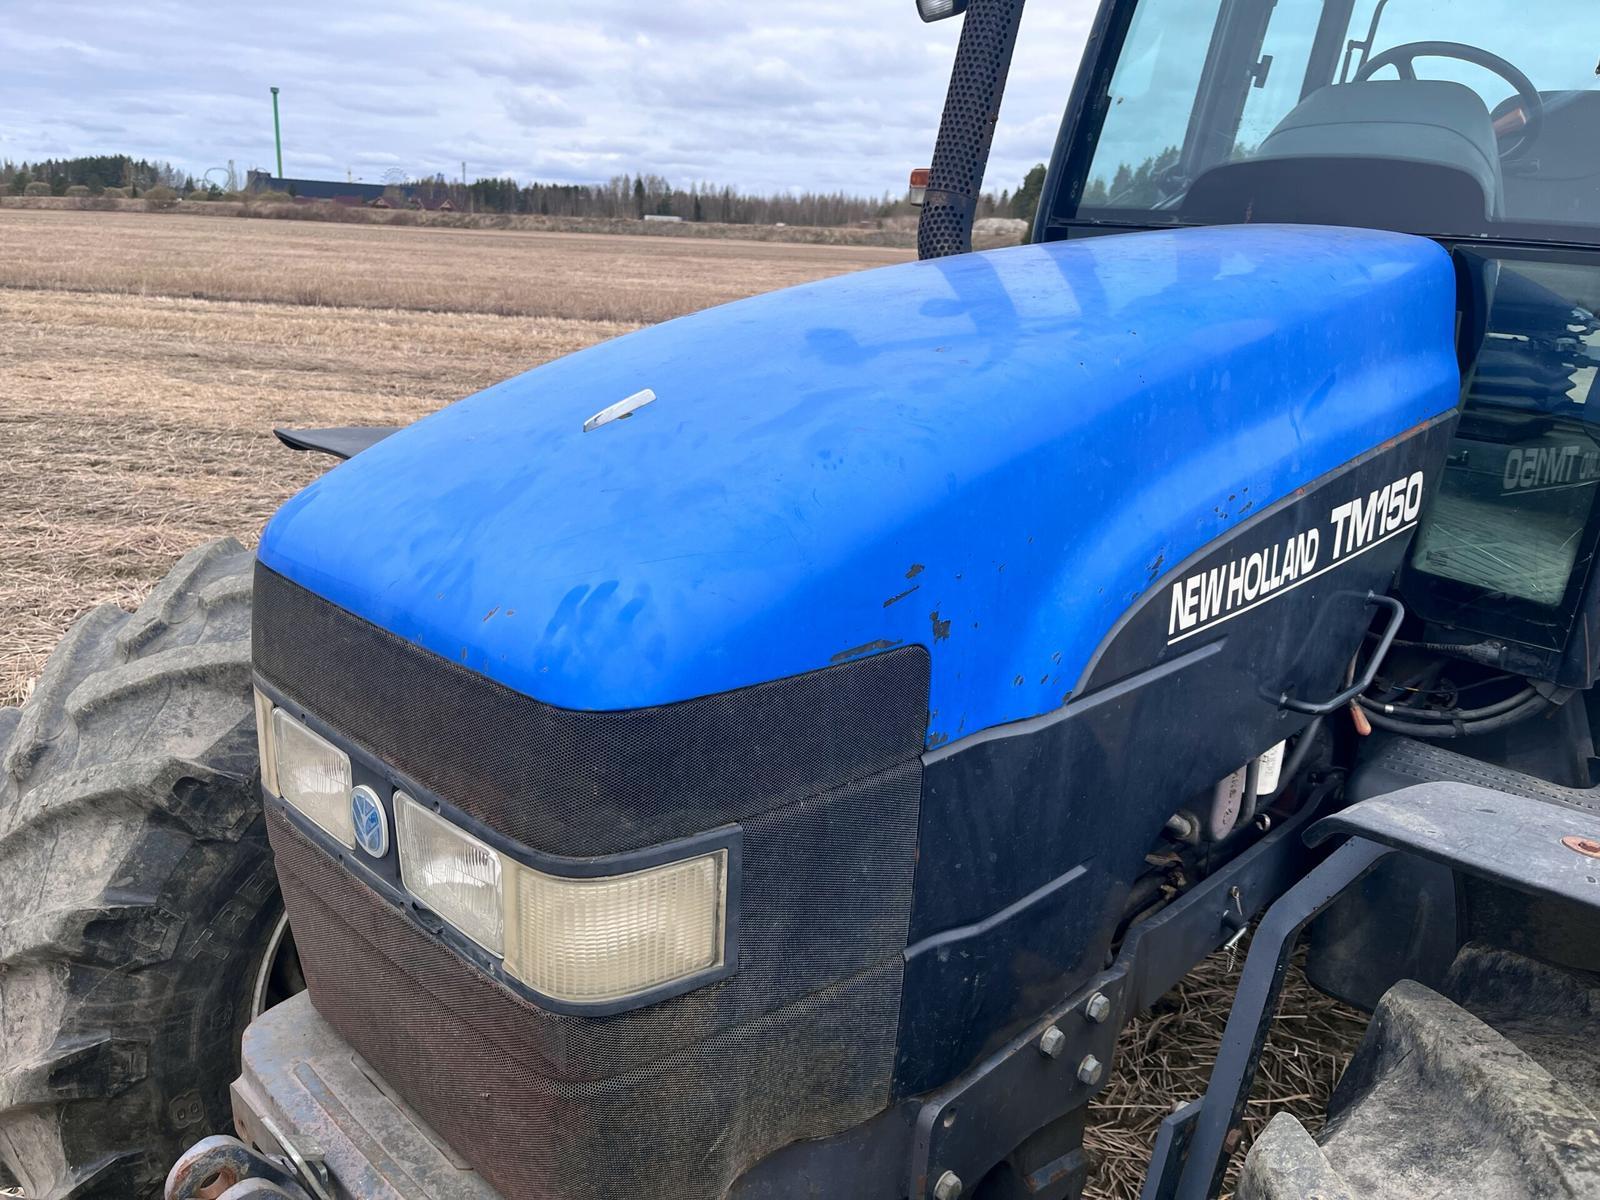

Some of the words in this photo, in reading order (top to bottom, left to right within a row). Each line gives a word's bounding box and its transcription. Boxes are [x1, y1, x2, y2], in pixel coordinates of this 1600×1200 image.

[1168, 564, 1227, 636] NEW
[1226, 527, 1320, 611] HOLLAND
[1330, 470, 1424, 560] TM150
